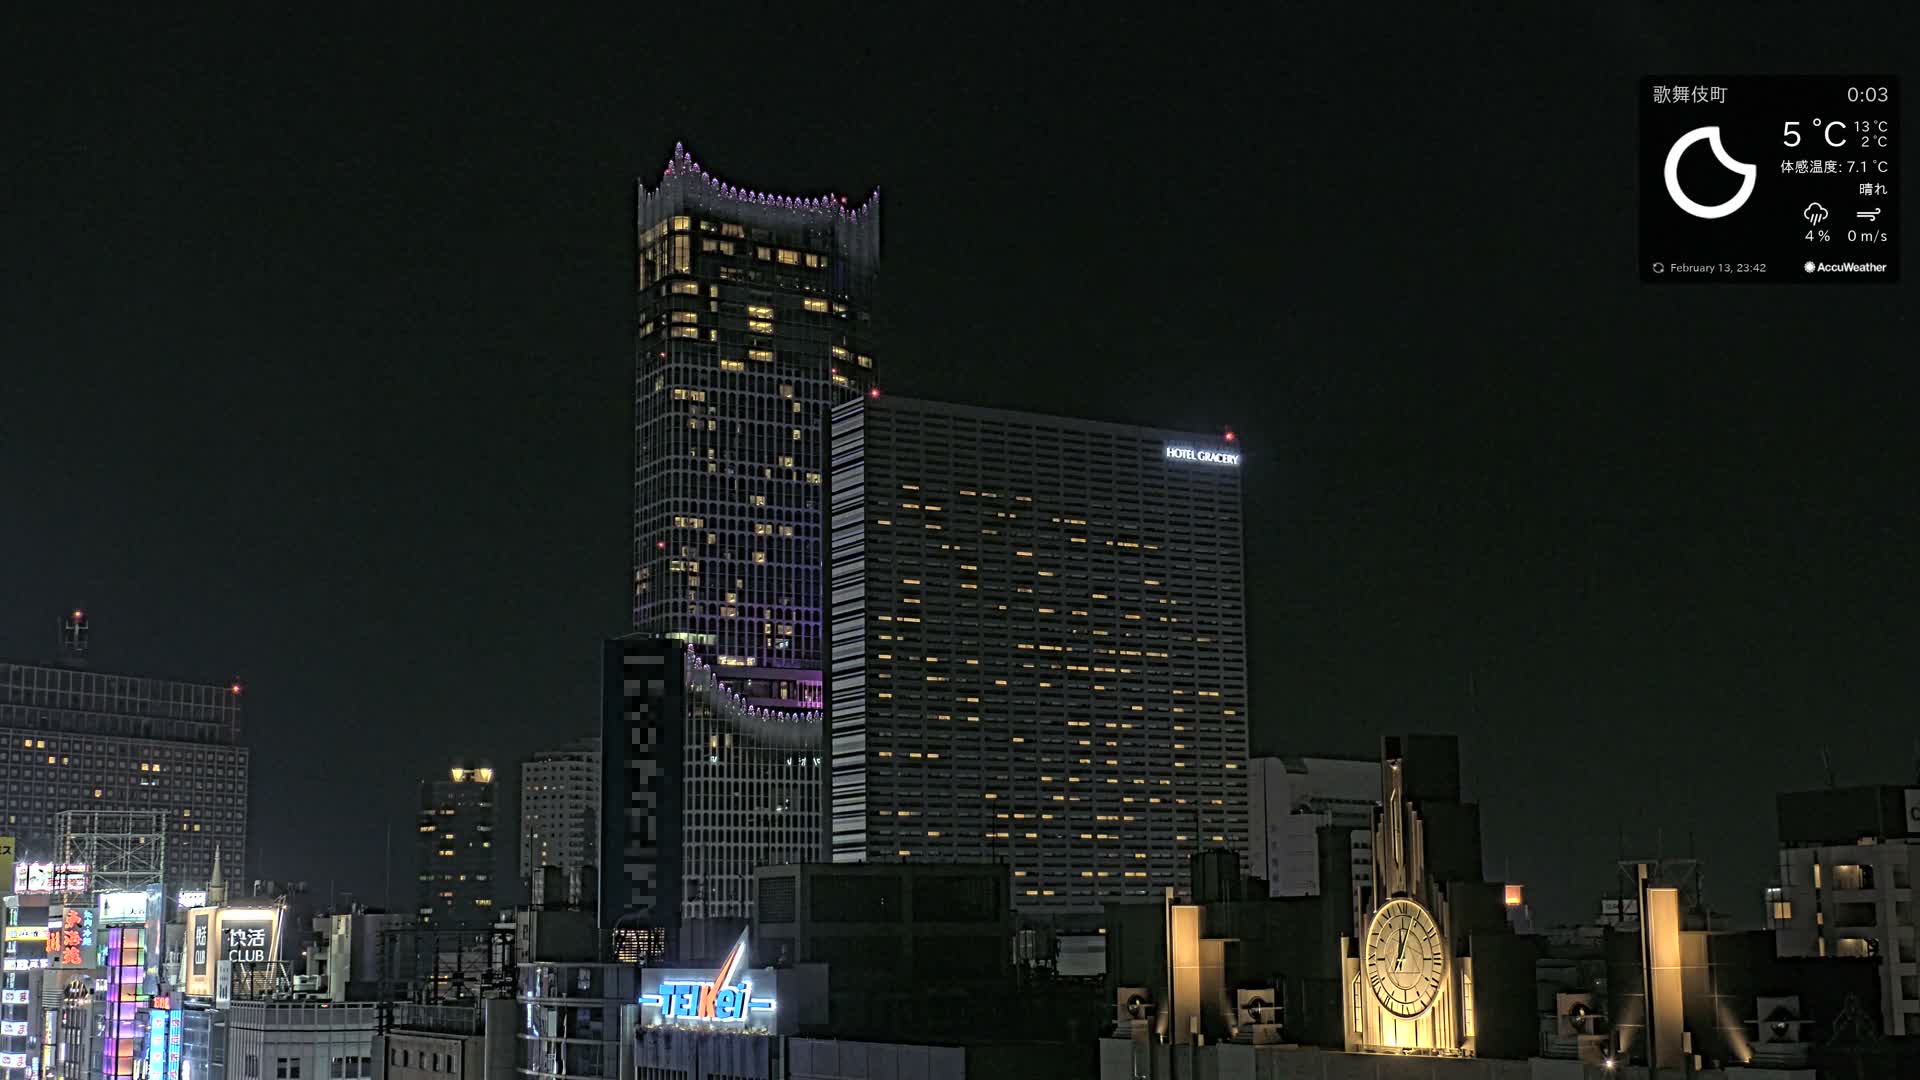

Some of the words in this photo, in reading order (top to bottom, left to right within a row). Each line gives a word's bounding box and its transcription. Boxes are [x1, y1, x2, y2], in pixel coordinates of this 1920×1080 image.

[1166, 447, 1196, 460] HOTEL
[1197, 451, 1239, 464] GRACERY
[228, 928, 265, 947] 快活
[229, 949, 264, 962] CLUB
